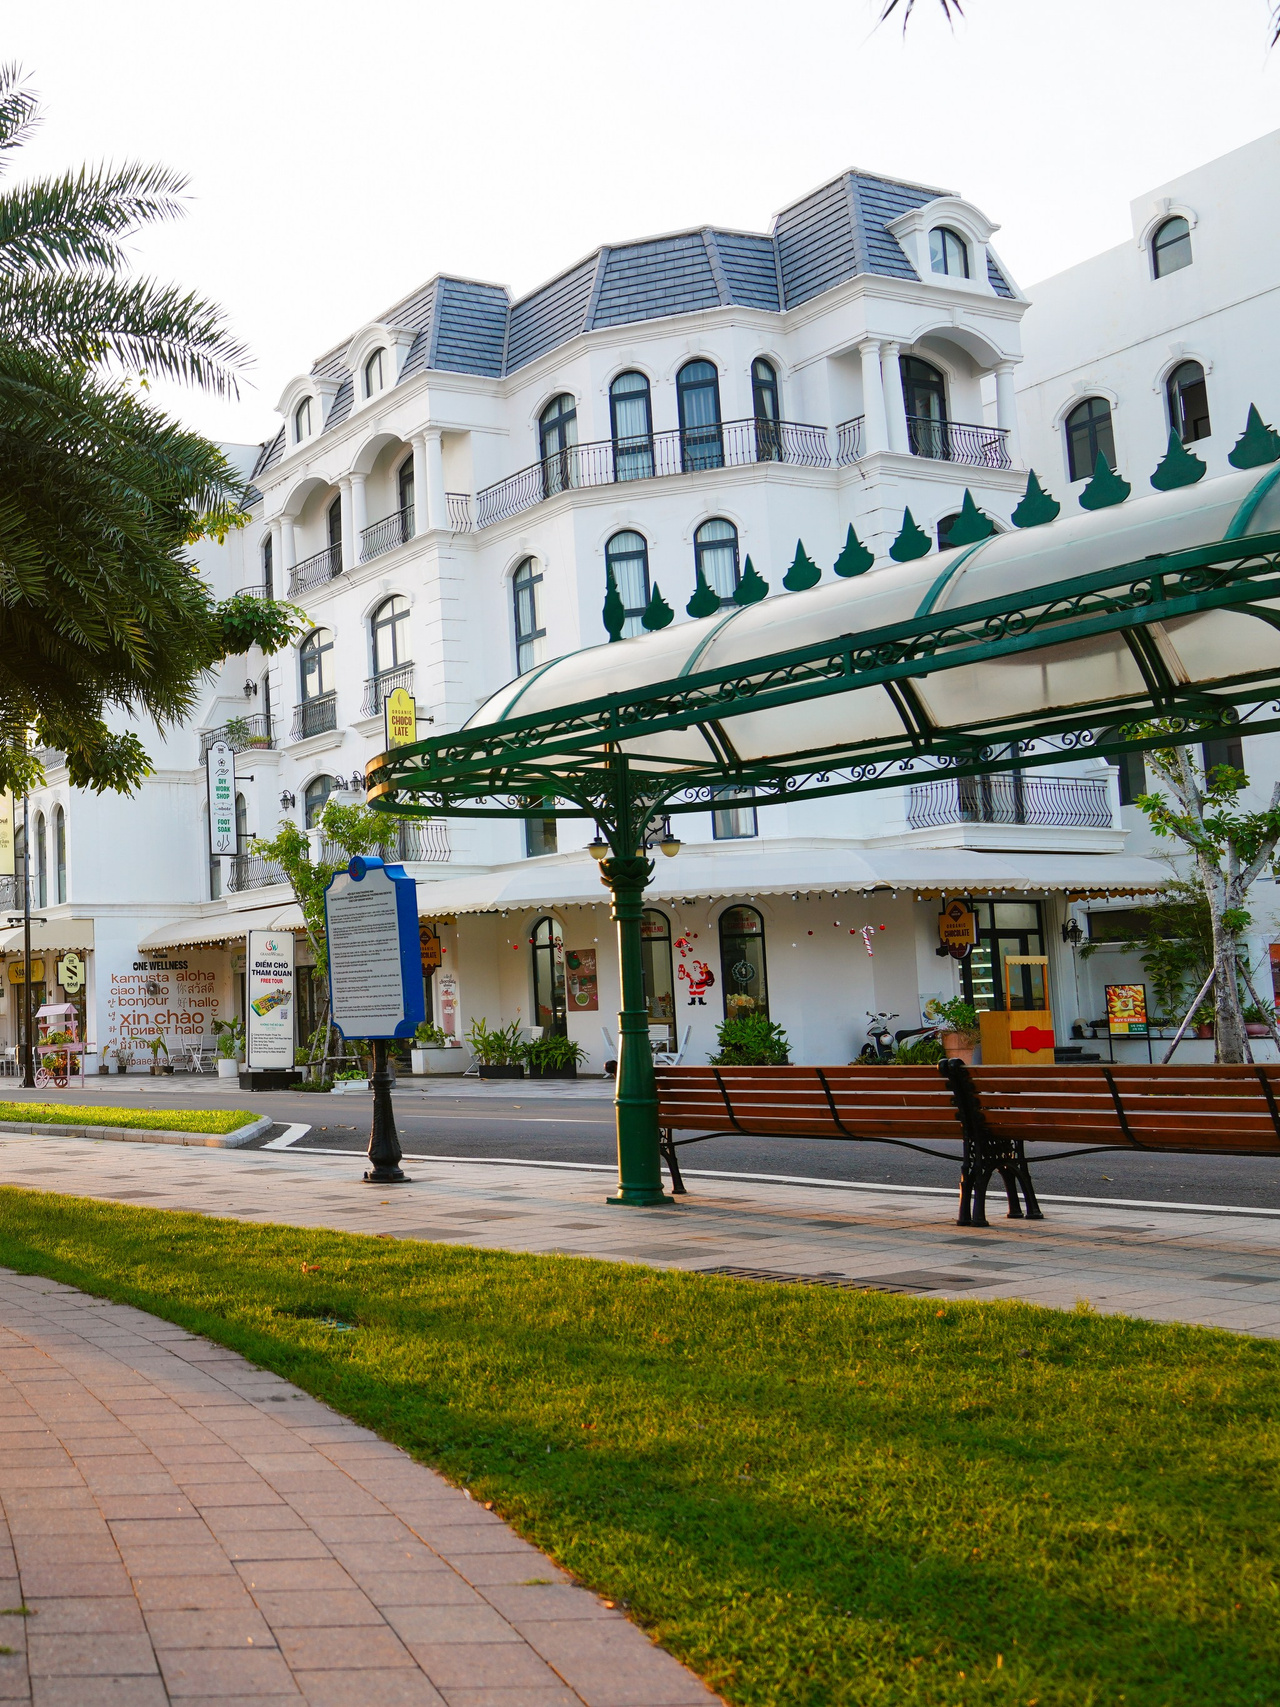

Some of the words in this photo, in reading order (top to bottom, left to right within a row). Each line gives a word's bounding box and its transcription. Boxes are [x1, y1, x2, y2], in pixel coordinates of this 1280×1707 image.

[392, 716, 412, 726] CHOCO
[394, 726, 409, 736] LATE
[944, 929, 970, 937] CHOCOLATE
[133, 962, 148, 971] ONE
[149, 960, 188, 970] WELLNESS
[111, 973, 169, 984] kamusta
[176, 970, 215, 982] aloha
[110, 986, 135, 995] ciao
[118, 996, 169, 1008] bonjour
[189, 997, 219, 1007] hallo
[120, 1010, 149, 1025] xin
[154, 1009, 204, 1025] chào
[120, 1025, 170, 1036] Привет
[175, 1024, 204, 1034] halo
